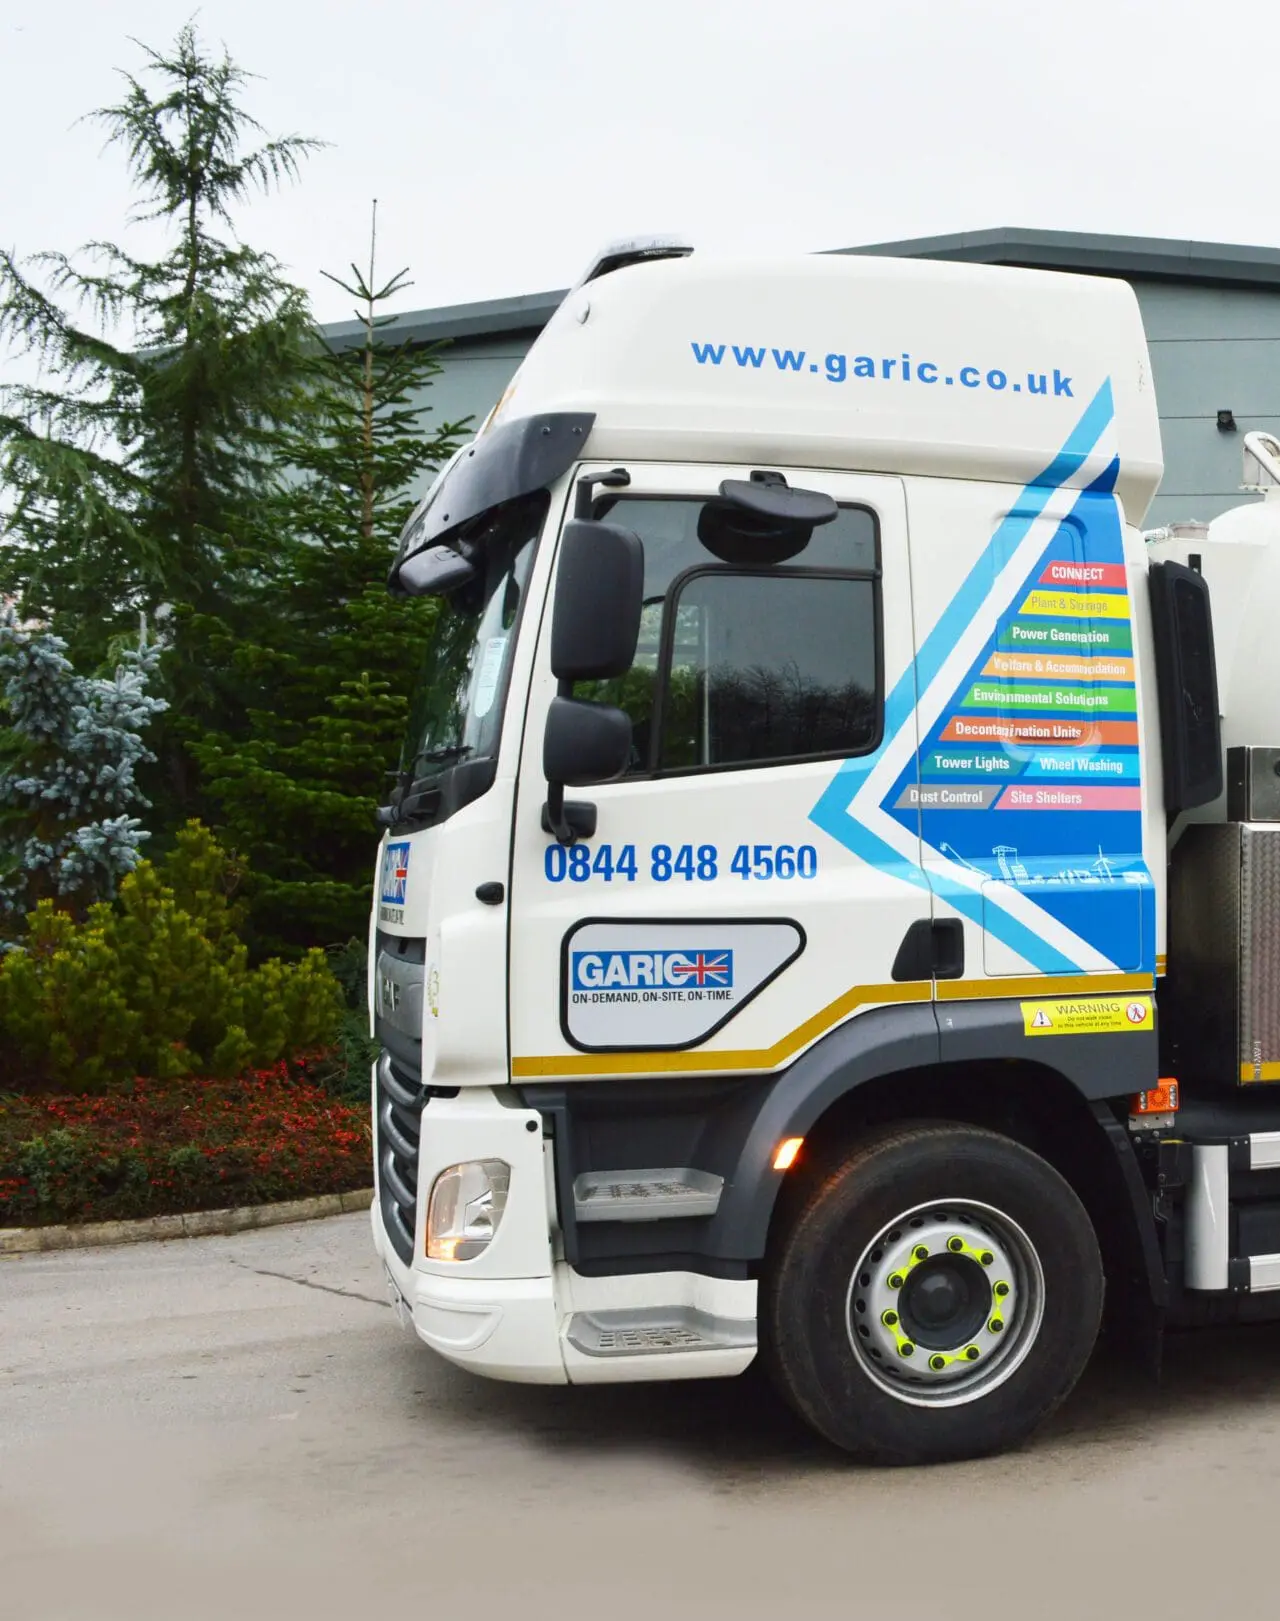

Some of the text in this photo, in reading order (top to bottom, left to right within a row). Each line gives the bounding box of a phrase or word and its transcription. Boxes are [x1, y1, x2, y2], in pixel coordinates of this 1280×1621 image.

[691, 342, 1074, 397] www.garic.co.uk
[1051, 566, 1104, 580] CONNECT
[1031, 596, 1056, 609] Plant
[1059, 598, 1066, 609] &
[1012, 626, 1109, 643] Power Generation
[1035, 659, 1043, 673] &
[974, 687, 1109, 706] Environmental Solutions
[1053, 725, 1081, 739] Units
[934, 755, 1010, 772] Tower Lights
[1039, 757, 1124, 774] Wheel Washing
[910, 790, 983, 803] Dust Control
[1010, 791, 1083, 804] Site Shelters
[544, 844, 818, 882] 0844 848 4560
[577, 953, 692, 987] GARIC
[572, 992, 640, 1004] ON-DEMAND,
[1055, 1003, 1120, 1015] WARNING
